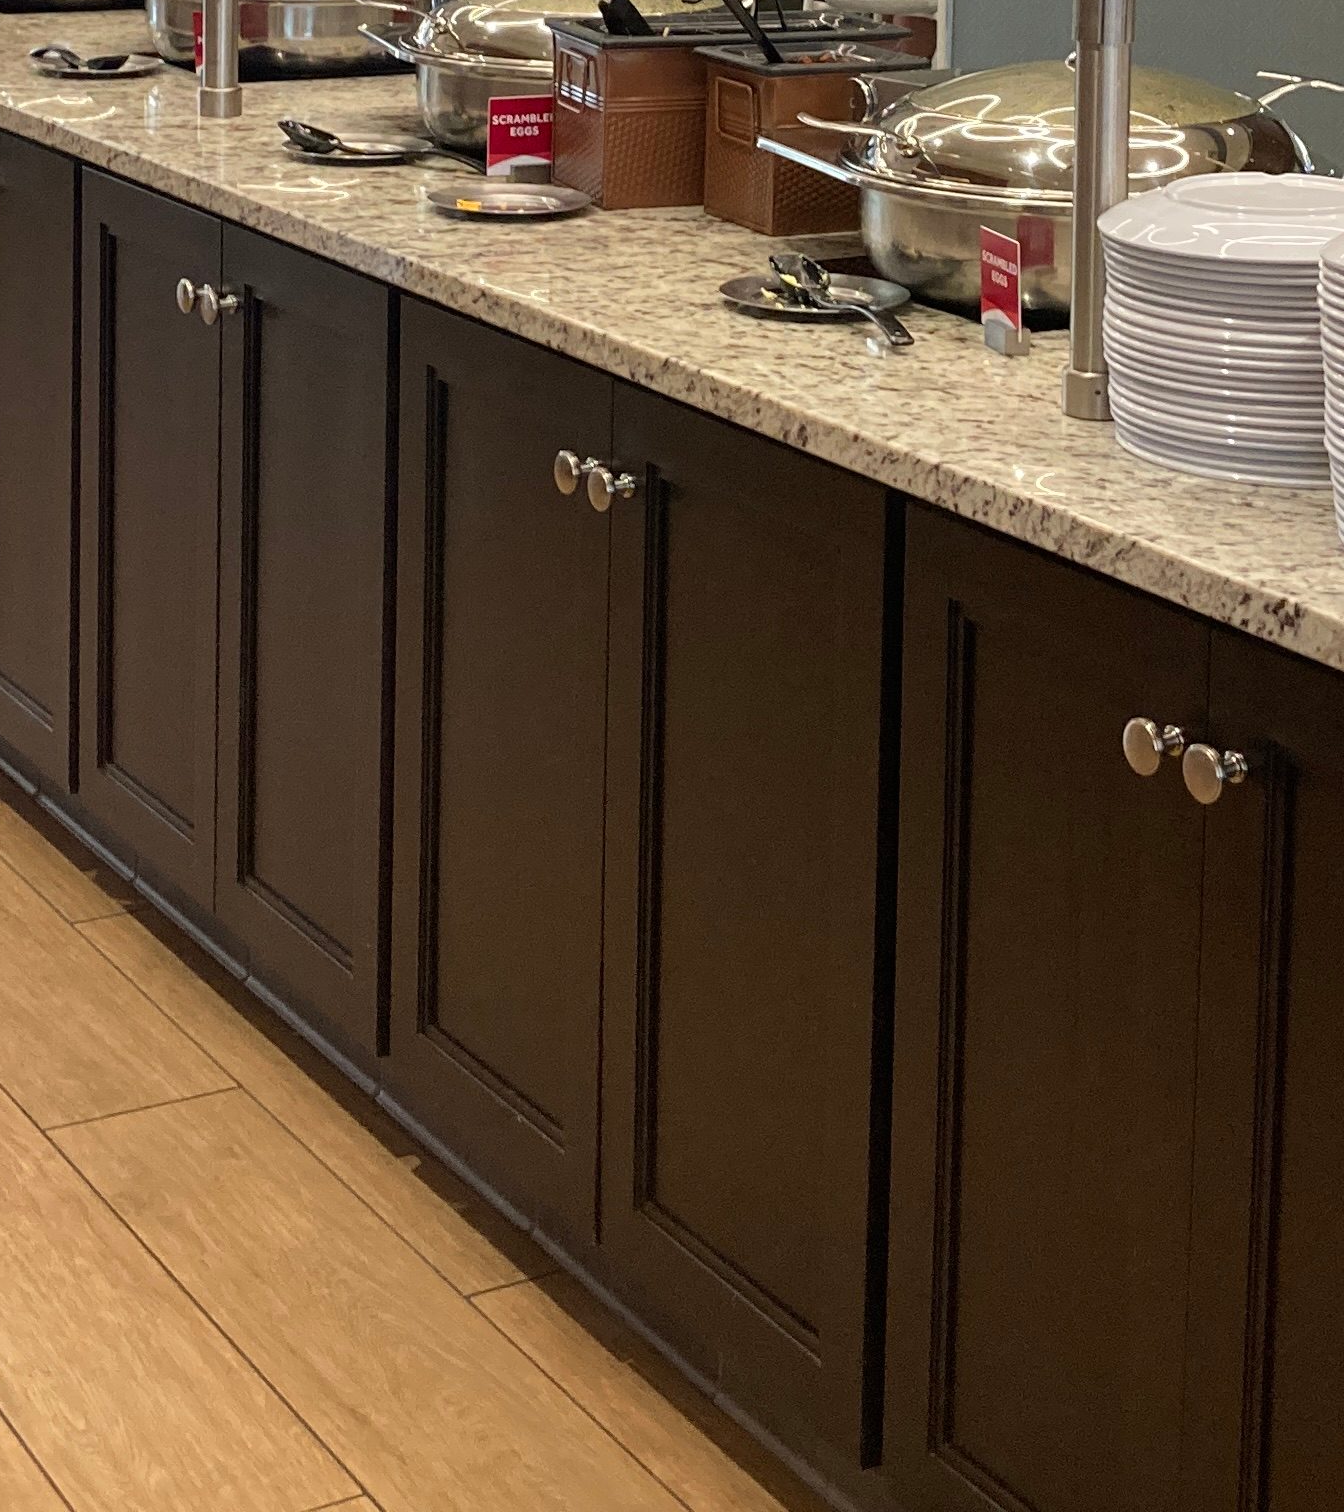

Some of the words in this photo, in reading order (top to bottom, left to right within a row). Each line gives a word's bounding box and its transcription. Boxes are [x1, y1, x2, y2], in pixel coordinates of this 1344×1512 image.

[509, 125, 540, 137] EGGS
[982, 249, 1018, 276] SCRAMBLED
[991, 269, 1008, 288] EGGS
